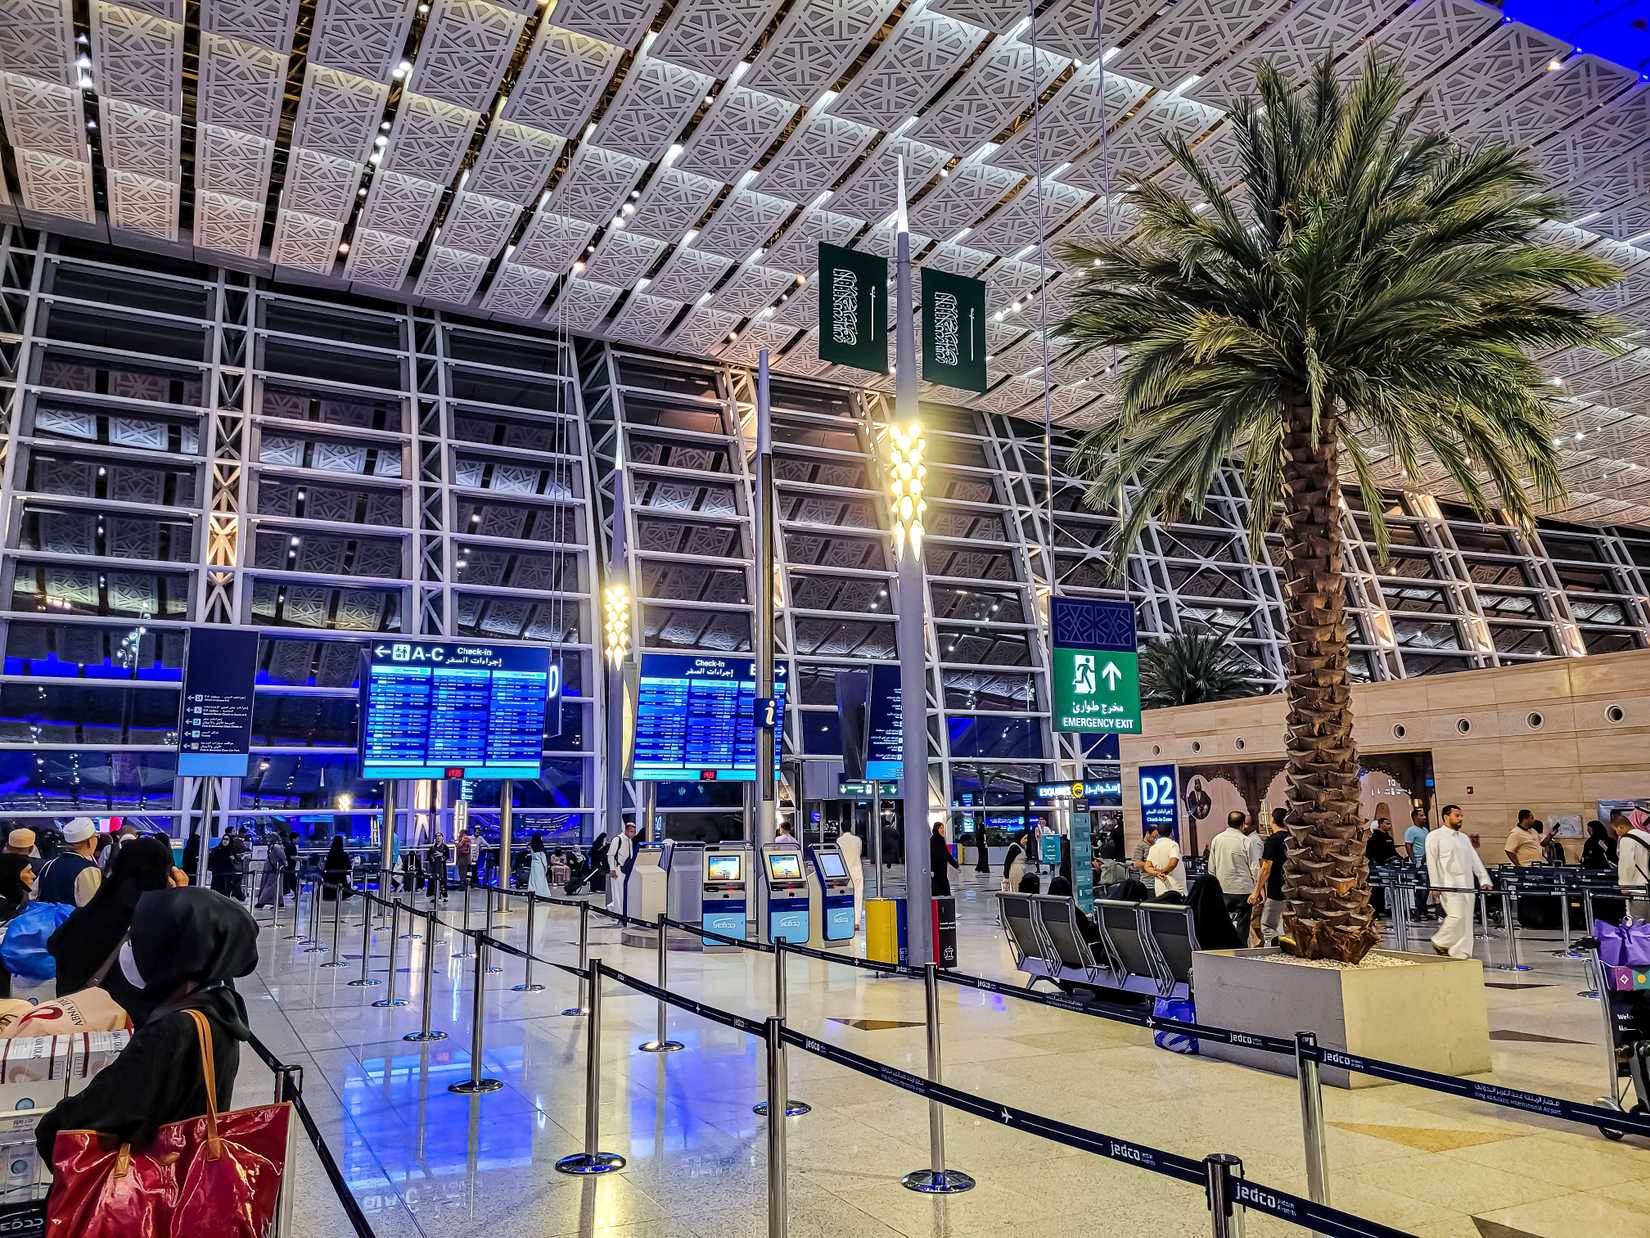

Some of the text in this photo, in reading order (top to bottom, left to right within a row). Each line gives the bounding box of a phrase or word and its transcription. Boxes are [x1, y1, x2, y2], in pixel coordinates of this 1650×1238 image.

[411, 646, 492, 661] A-C Check-in
[695, 659, 725, 667] Check-in
[1102, 702, 1124, 714] مخرج
[1063, 717, 1134, 729] EMERGENCY EXIT
[1141, 776, 1174, 805] D2
[1229, 1032, 1252, 1045] jedco
[1323, 1050, 1351, 1066] jedco
[1110, 1140, 1141, 1161] jedco
[1236, 1182, 1276, 1209] jedco
